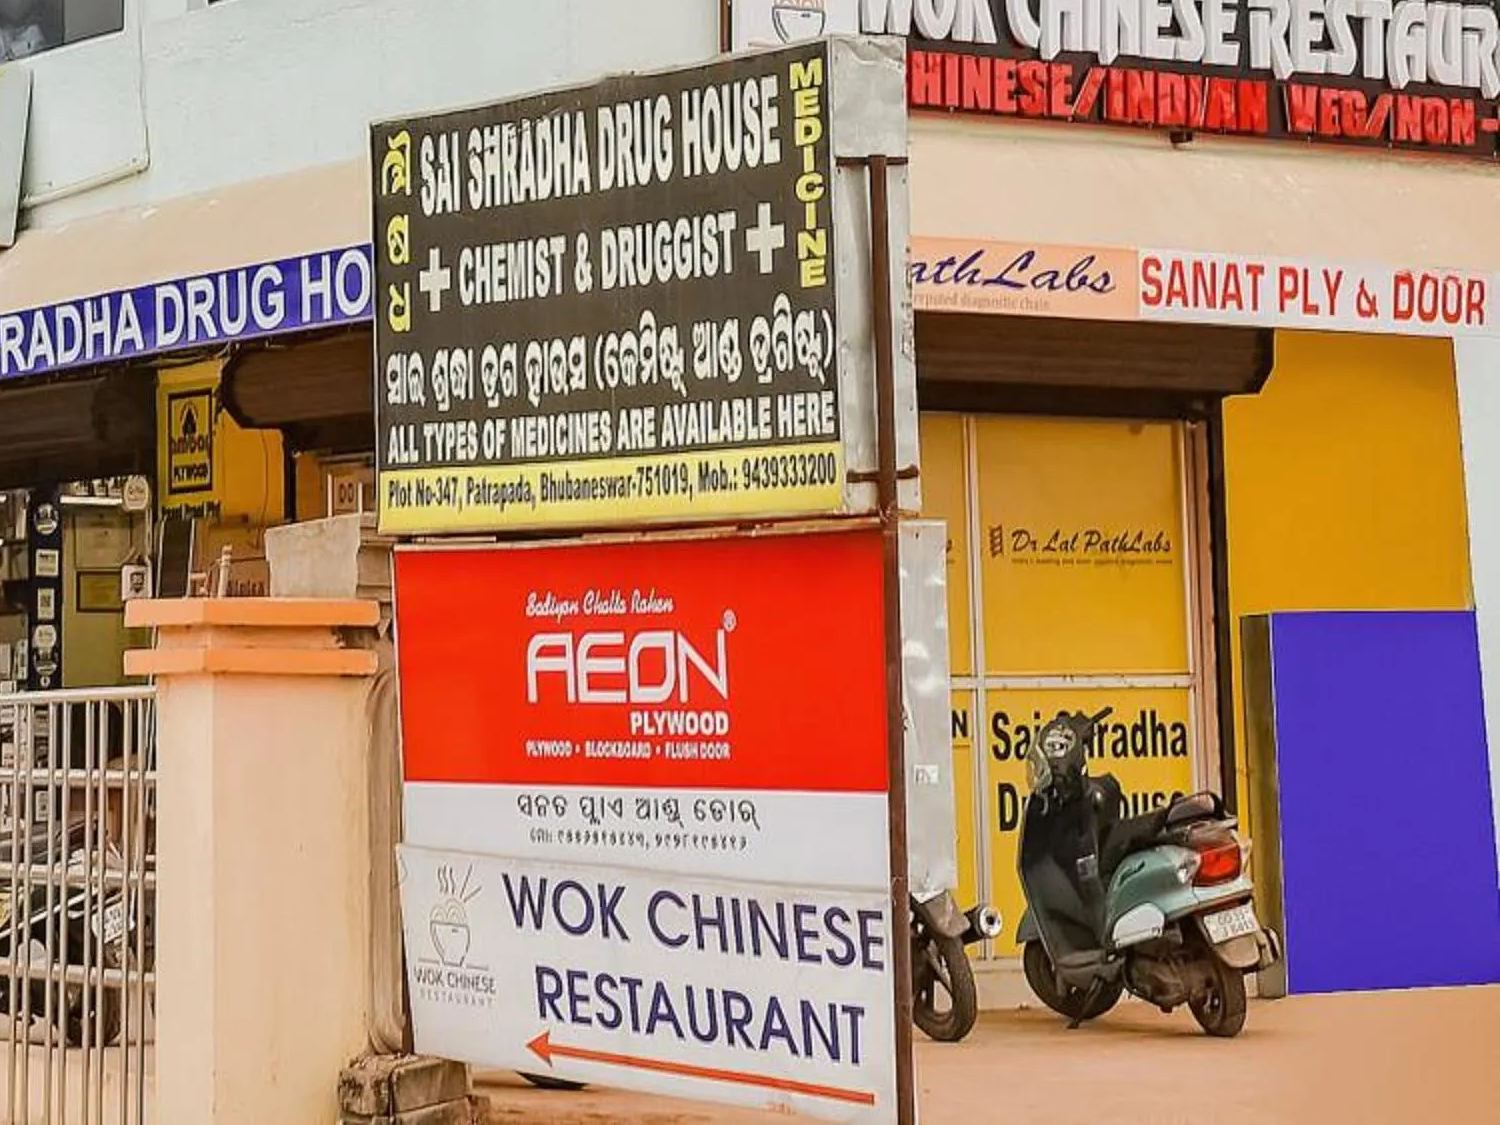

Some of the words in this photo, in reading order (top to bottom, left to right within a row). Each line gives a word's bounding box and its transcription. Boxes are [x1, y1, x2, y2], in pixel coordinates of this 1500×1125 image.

[910, 49, 1268, 133] HINESE/INDIAN
[420, 131, 461, 217] SAI
[467, 107, 591, 212] SHRADHA
[598, 93, 673, 191] DRUG
[682, 73, 782, 176] HOUSE
[789, 58, 828, 289] MEDICINE
[458, 233, 567, 305] CHEMIST
[574, 232, 593, 294] &
[600, 210, 737, 291] DRUGGIST
[911, 249, 1117, 293] athLabs
[1141, 255, 1265, 313] SANAT
[1277, 267, 1343, 318] PLY
[1356, 278, 1378, 318] &
[1392, 270, 1486, 325] DOOR
[155, 272, 285, 344] DRUG
[387, 424, 419, 464] ALL
[423, 420, 478, 462] TYPES
[481, 418, 506, 459] OF
[510, 411, 613, 458] MEDICINES
[617, 405, 656, 451] ARE
[660, 395, 771, 449] AVAILABLE
[778, 390, 836, 437] HERE
[387, 479, 411, 509] Plot
[465, 473, 536, 512] Patrapada,
[741, 452, 836, 490] 9439333200
[1011, 529, 1037, 552] Dr
[1042, 530, 1080, 553] Lal
[1083, 529, 1172, 554] PathLabs
[527, 629, 728, 704] AEON
[526, 740, 573, 757] PLYWOOD
[584, 740, 652, 759] BLOCKBOARD
[665, 741, 698, 759] FLUSH
[700, 742, 731, 760] DOOR
[630, 710, 730, 736] PLYWOOD
[501, 873, 631, 941] WOK
[647, 890, 886, 972] CHINESE
[447, 971, 497, 995] CHINESE
[535, 965, 866, 1067] RESTAURANT
